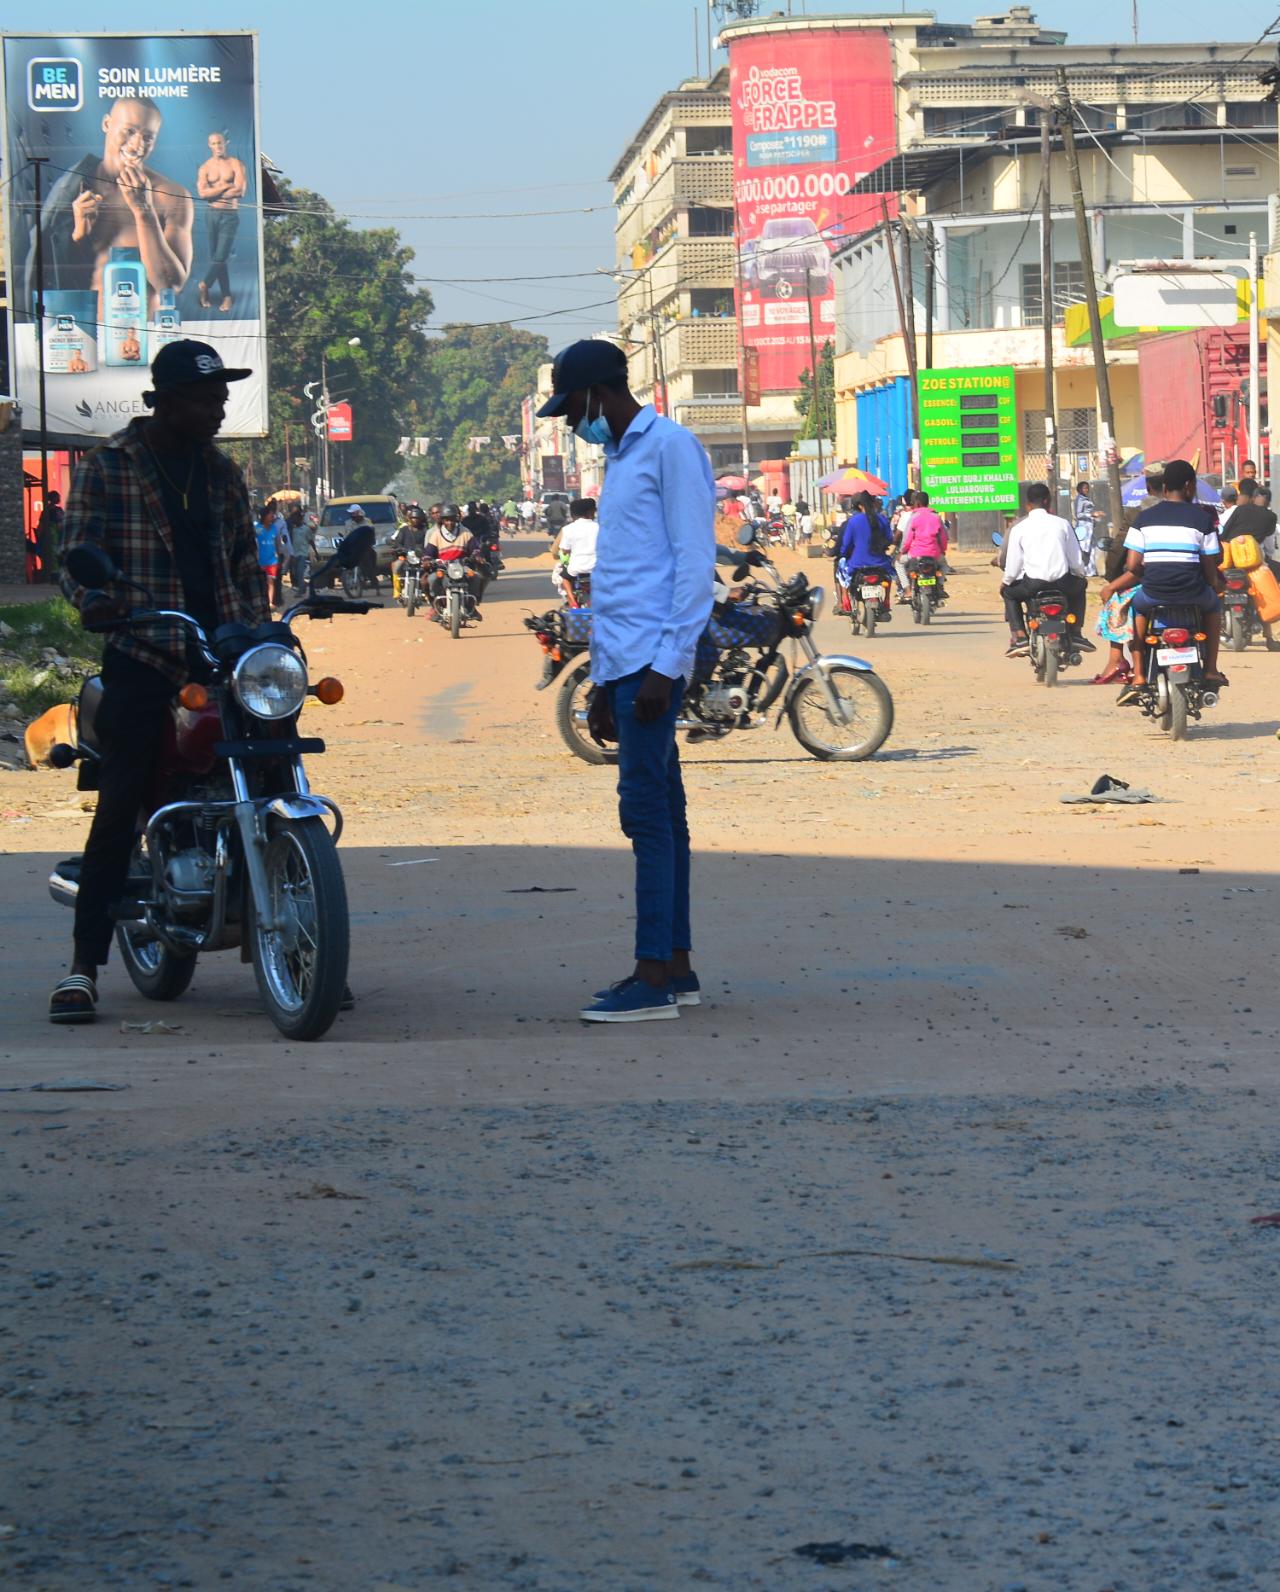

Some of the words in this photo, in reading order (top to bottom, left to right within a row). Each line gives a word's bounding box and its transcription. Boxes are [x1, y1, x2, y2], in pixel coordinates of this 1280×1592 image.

[43, 68, 67, 83] BE
[98, 67, 140, 83] SOIN
[144, 64, 221, 83] LUMIÈRE
[760, 67, 798, 77] vodacom
[35, 83, 76, 99] MEN
[98, 86, 136, 98] POUR
[139, 85, 188, 97] HOMME
[742, 76, 802, 106] FORCE
[752, 101, 837, 131] FRAPPE
[922, 378, 946, 390] ZOE
[948, 377, 1001, 389] STATION
